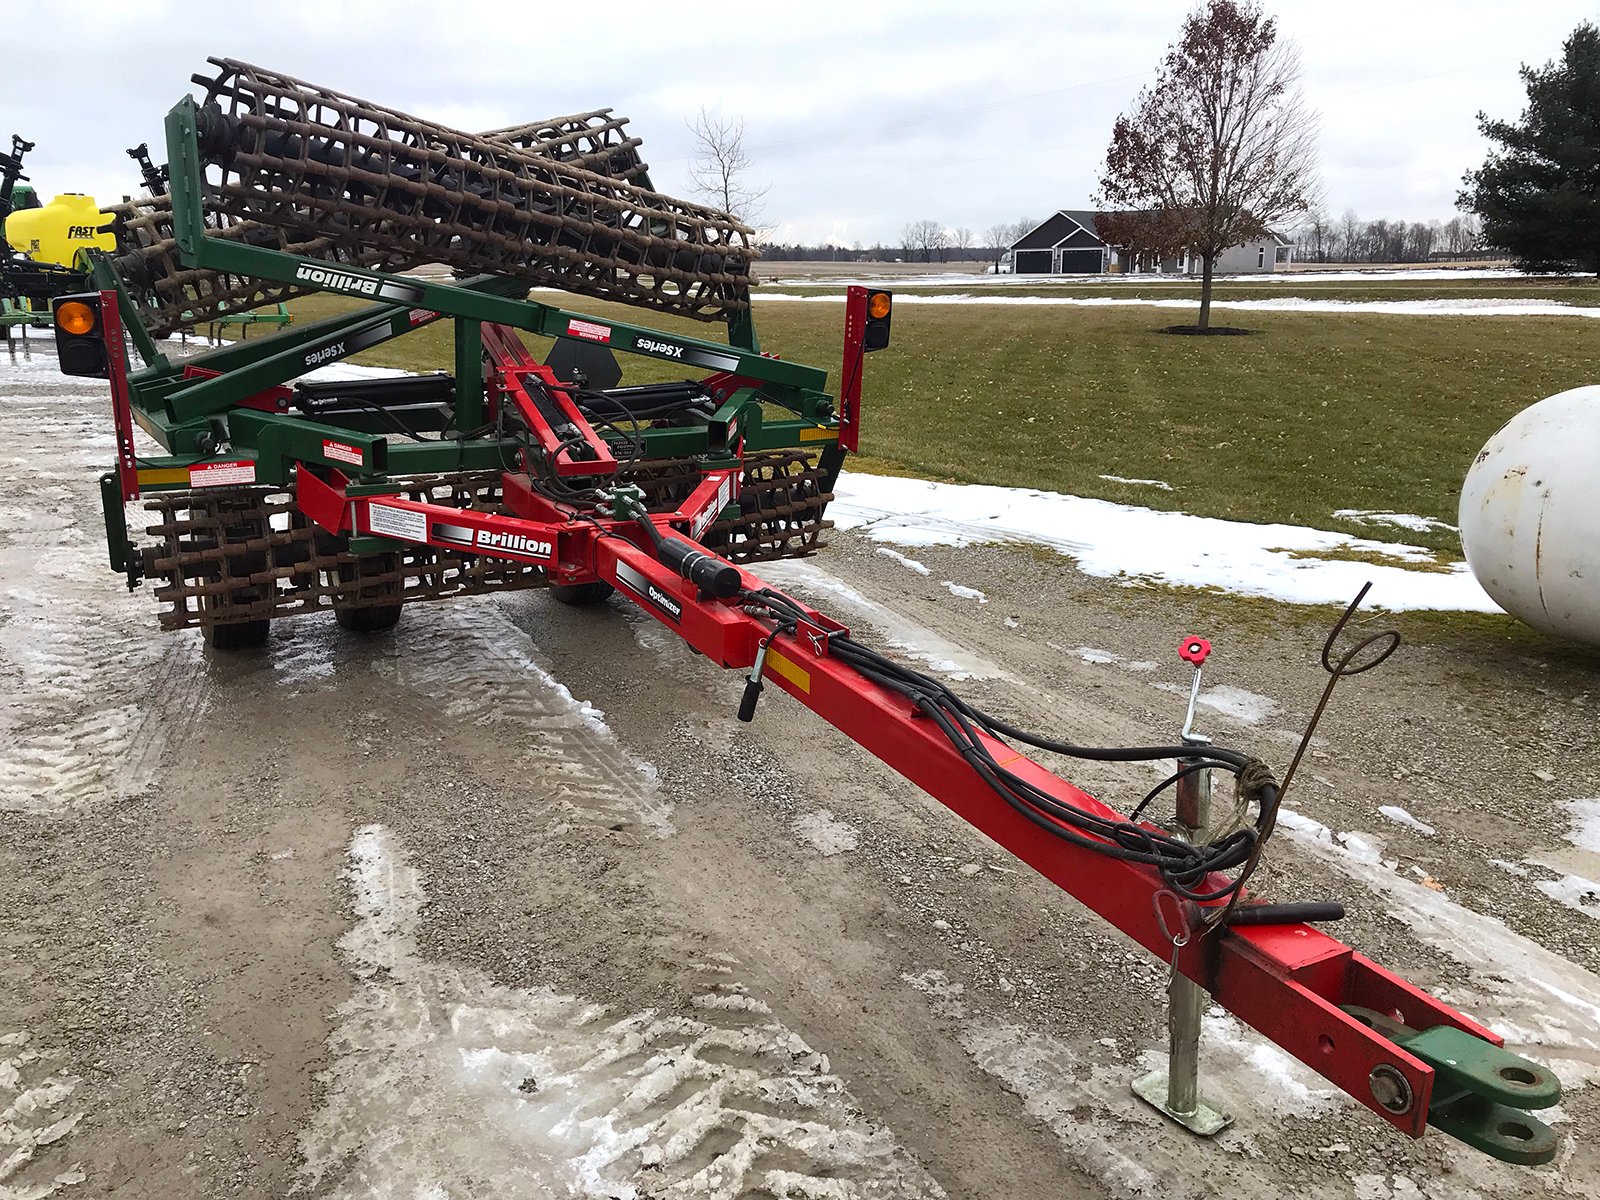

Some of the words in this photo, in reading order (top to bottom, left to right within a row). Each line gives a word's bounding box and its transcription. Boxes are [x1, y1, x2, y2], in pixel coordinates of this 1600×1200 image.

[68, 225, 95, 239] FAST
[296, 267, 378, 294] Brillion
[579, 331, 599, 341] DANGER
[333, 442, 353, 452] DANGER
[213, 462, 238, 470] DANGER
[477, 530, 552, 553] Brillion
[648, 585, 681, 616] Optimizer
